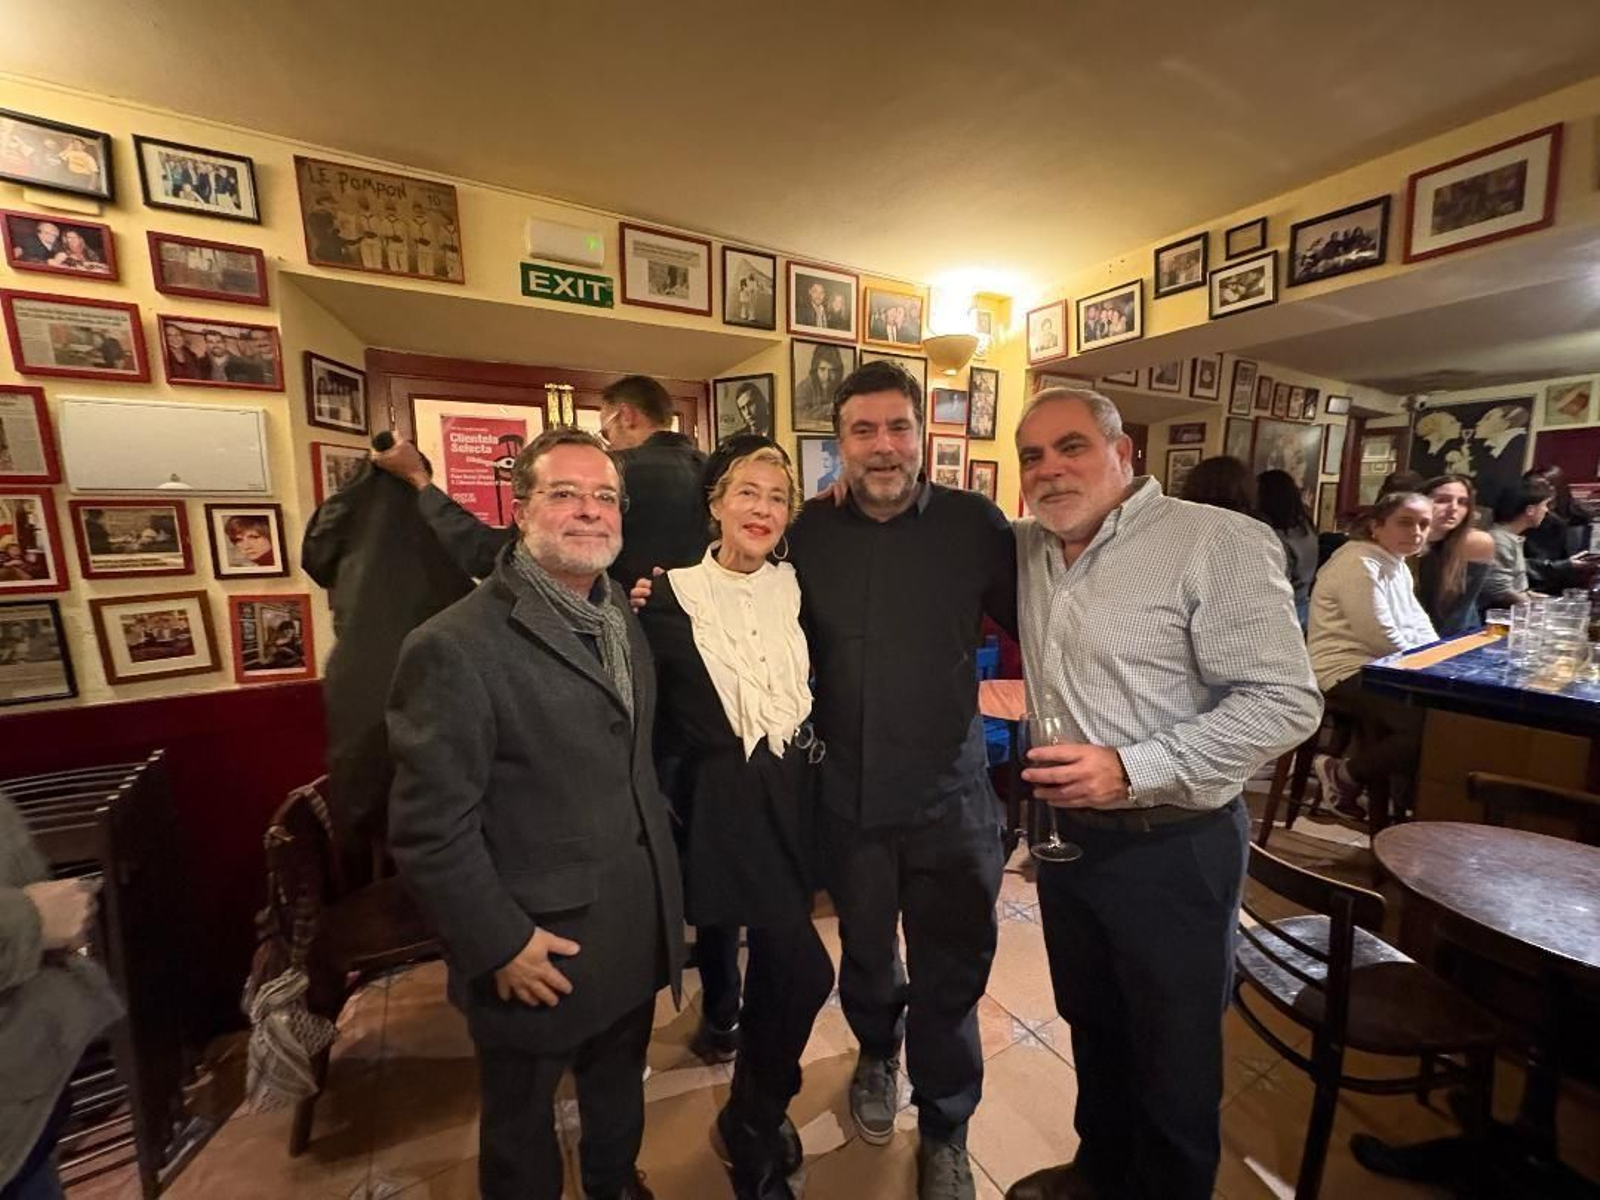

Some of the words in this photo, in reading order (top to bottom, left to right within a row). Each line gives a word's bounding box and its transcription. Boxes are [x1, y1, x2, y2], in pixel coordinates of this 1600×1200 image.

[308, 165, 331, 186] LE
[337, 171, 407, 200] POMPON
[529, 270, 606, 301] EXIT
[450, 433, 499, 445] Clientela
[451, 443, 492, 454] Selecta
